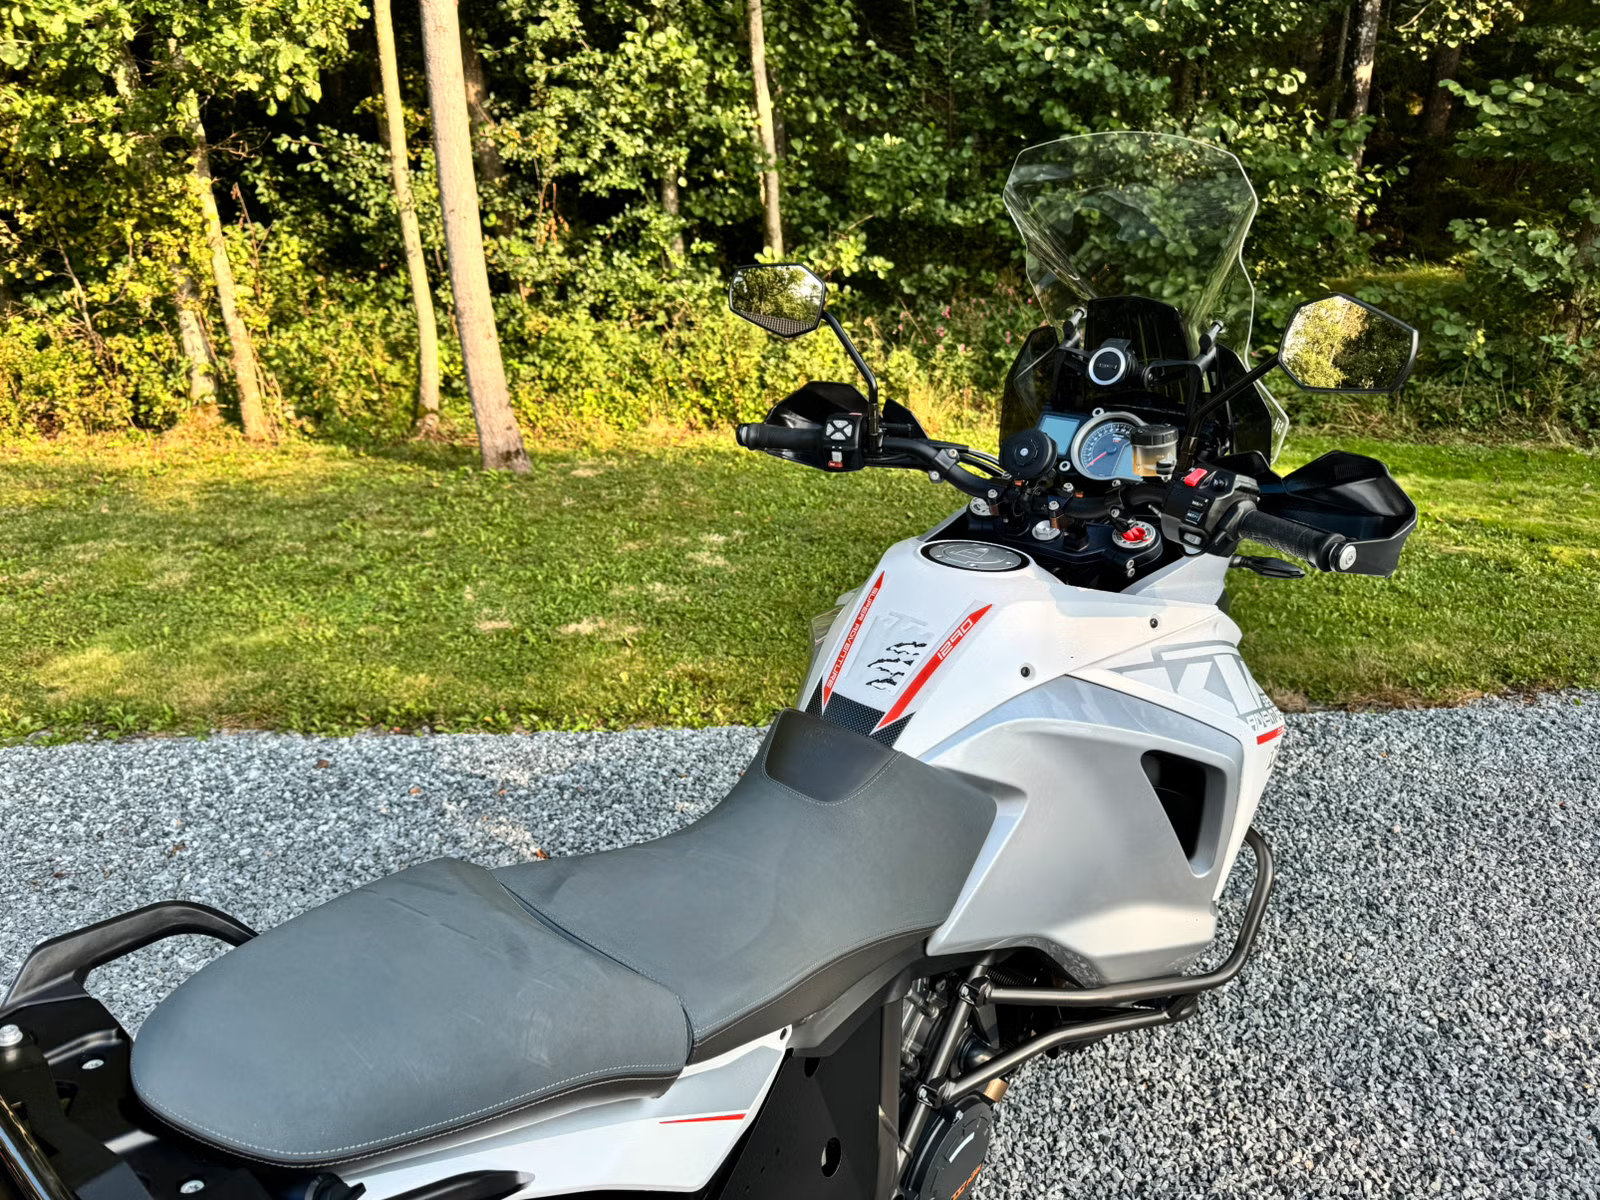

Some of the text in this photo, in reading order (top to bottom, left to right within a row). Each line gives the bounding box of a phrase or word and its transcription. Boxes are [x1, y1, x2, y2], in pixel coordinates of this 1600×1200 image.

[826, 587, 879, 688] SUPER ADVENTURE
[936, 618, 974, 661] 1290
